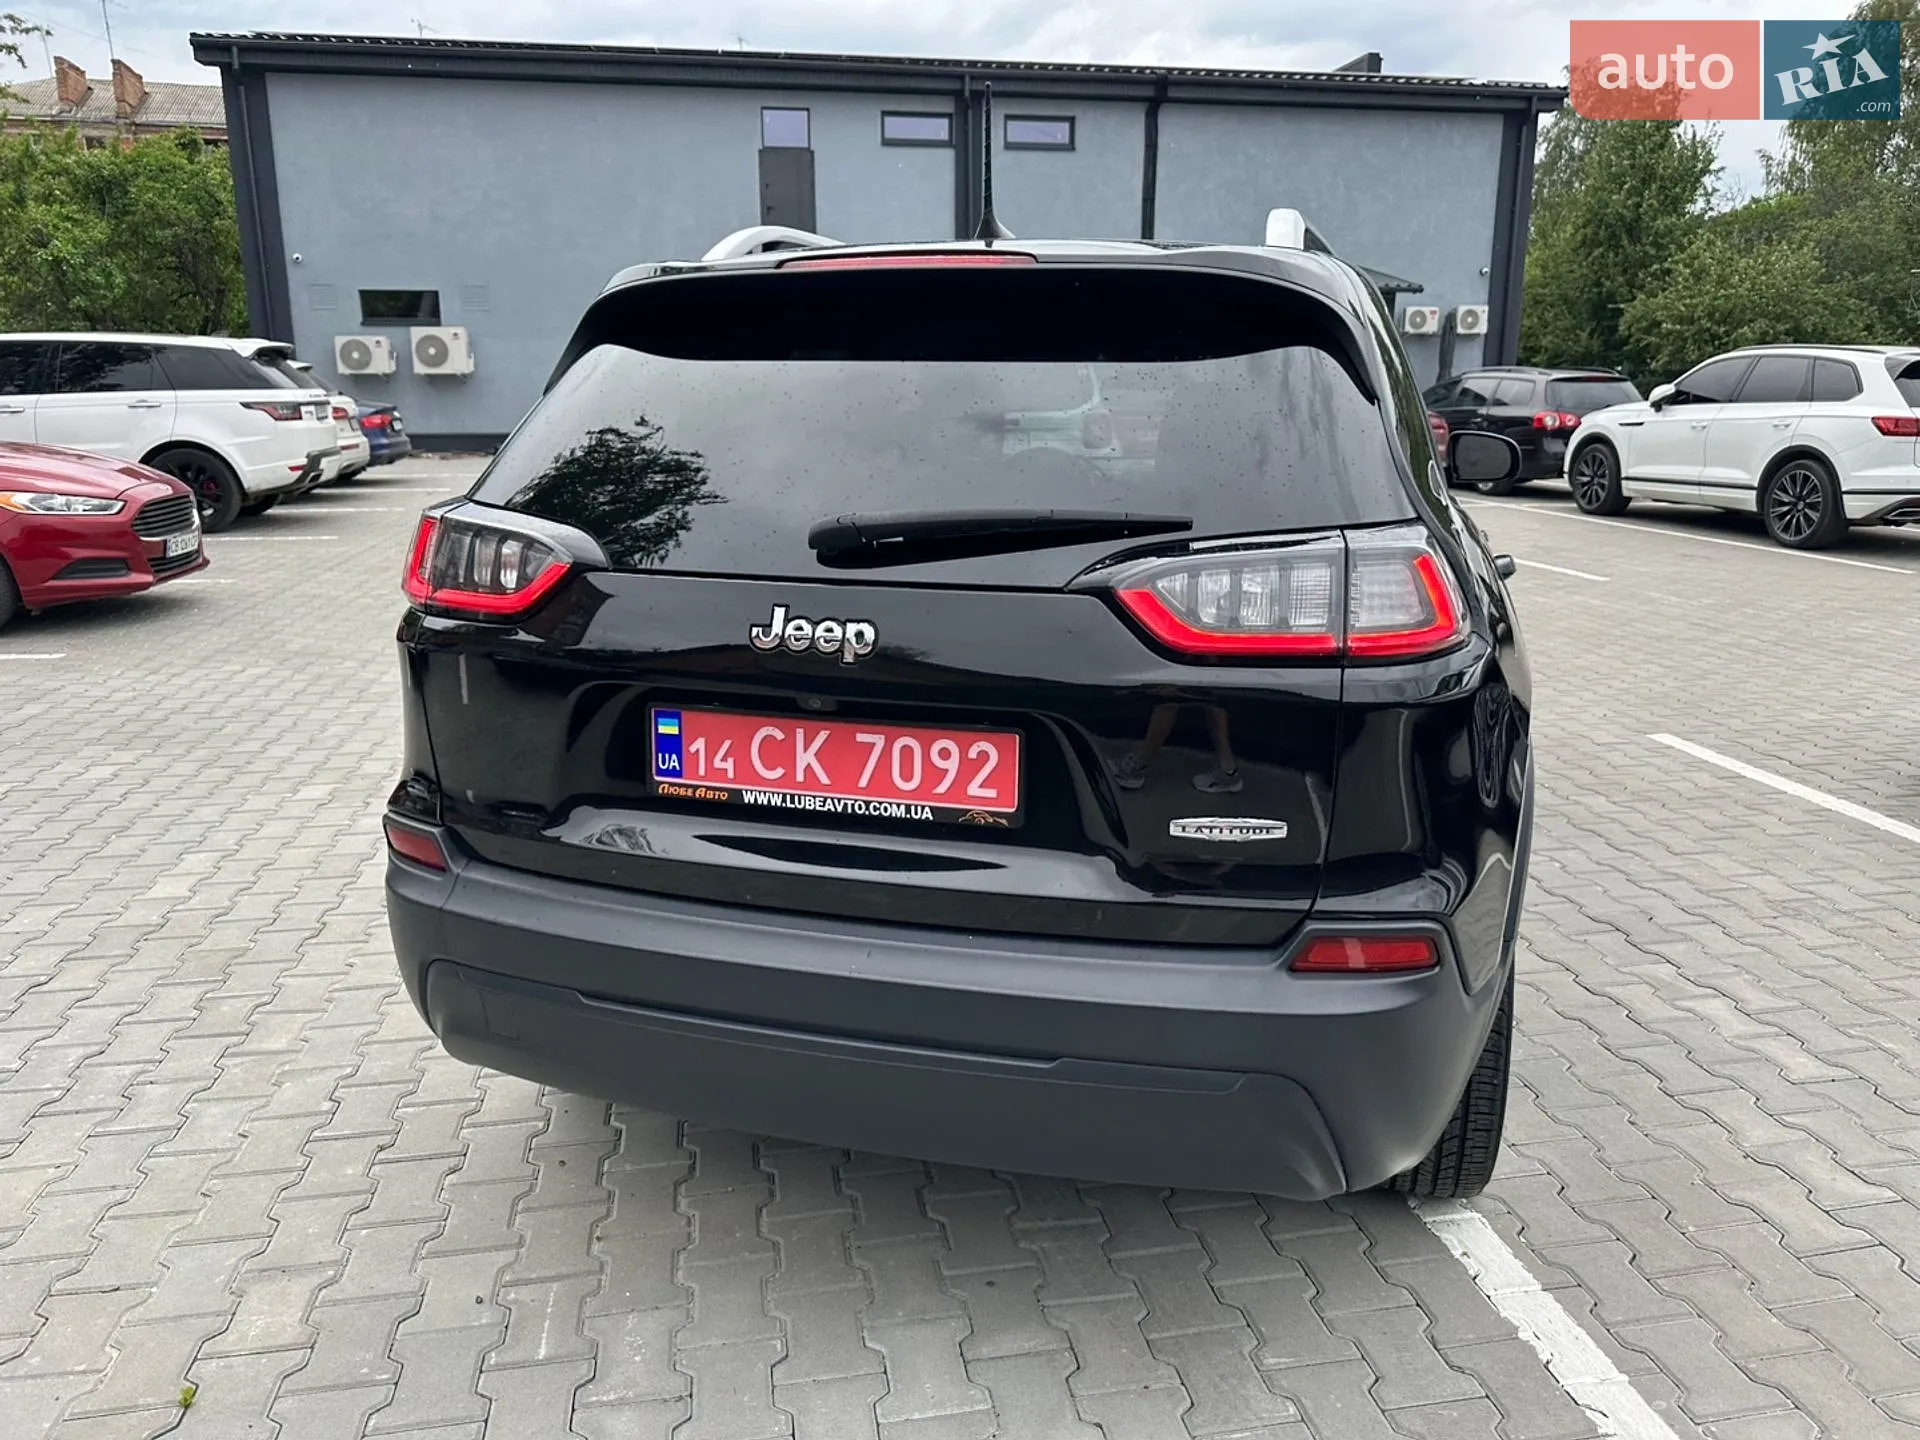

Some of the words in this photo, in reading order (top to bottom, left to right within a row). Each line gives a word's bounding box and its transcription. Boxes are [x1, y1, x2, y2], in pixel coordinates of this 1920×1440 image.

[751, 605, 876, 663] Jeep
[658, 753, 680, 770] UA
[688, 737, 735, 779] 14
[750, 726, 832, 785] CK
[855, 733, 999, 798] 7092
[742, 790, 933, 821] WWW.LUBEAVTO.COM.UA
[1180, 824, 1274, 835] LATITUDE
